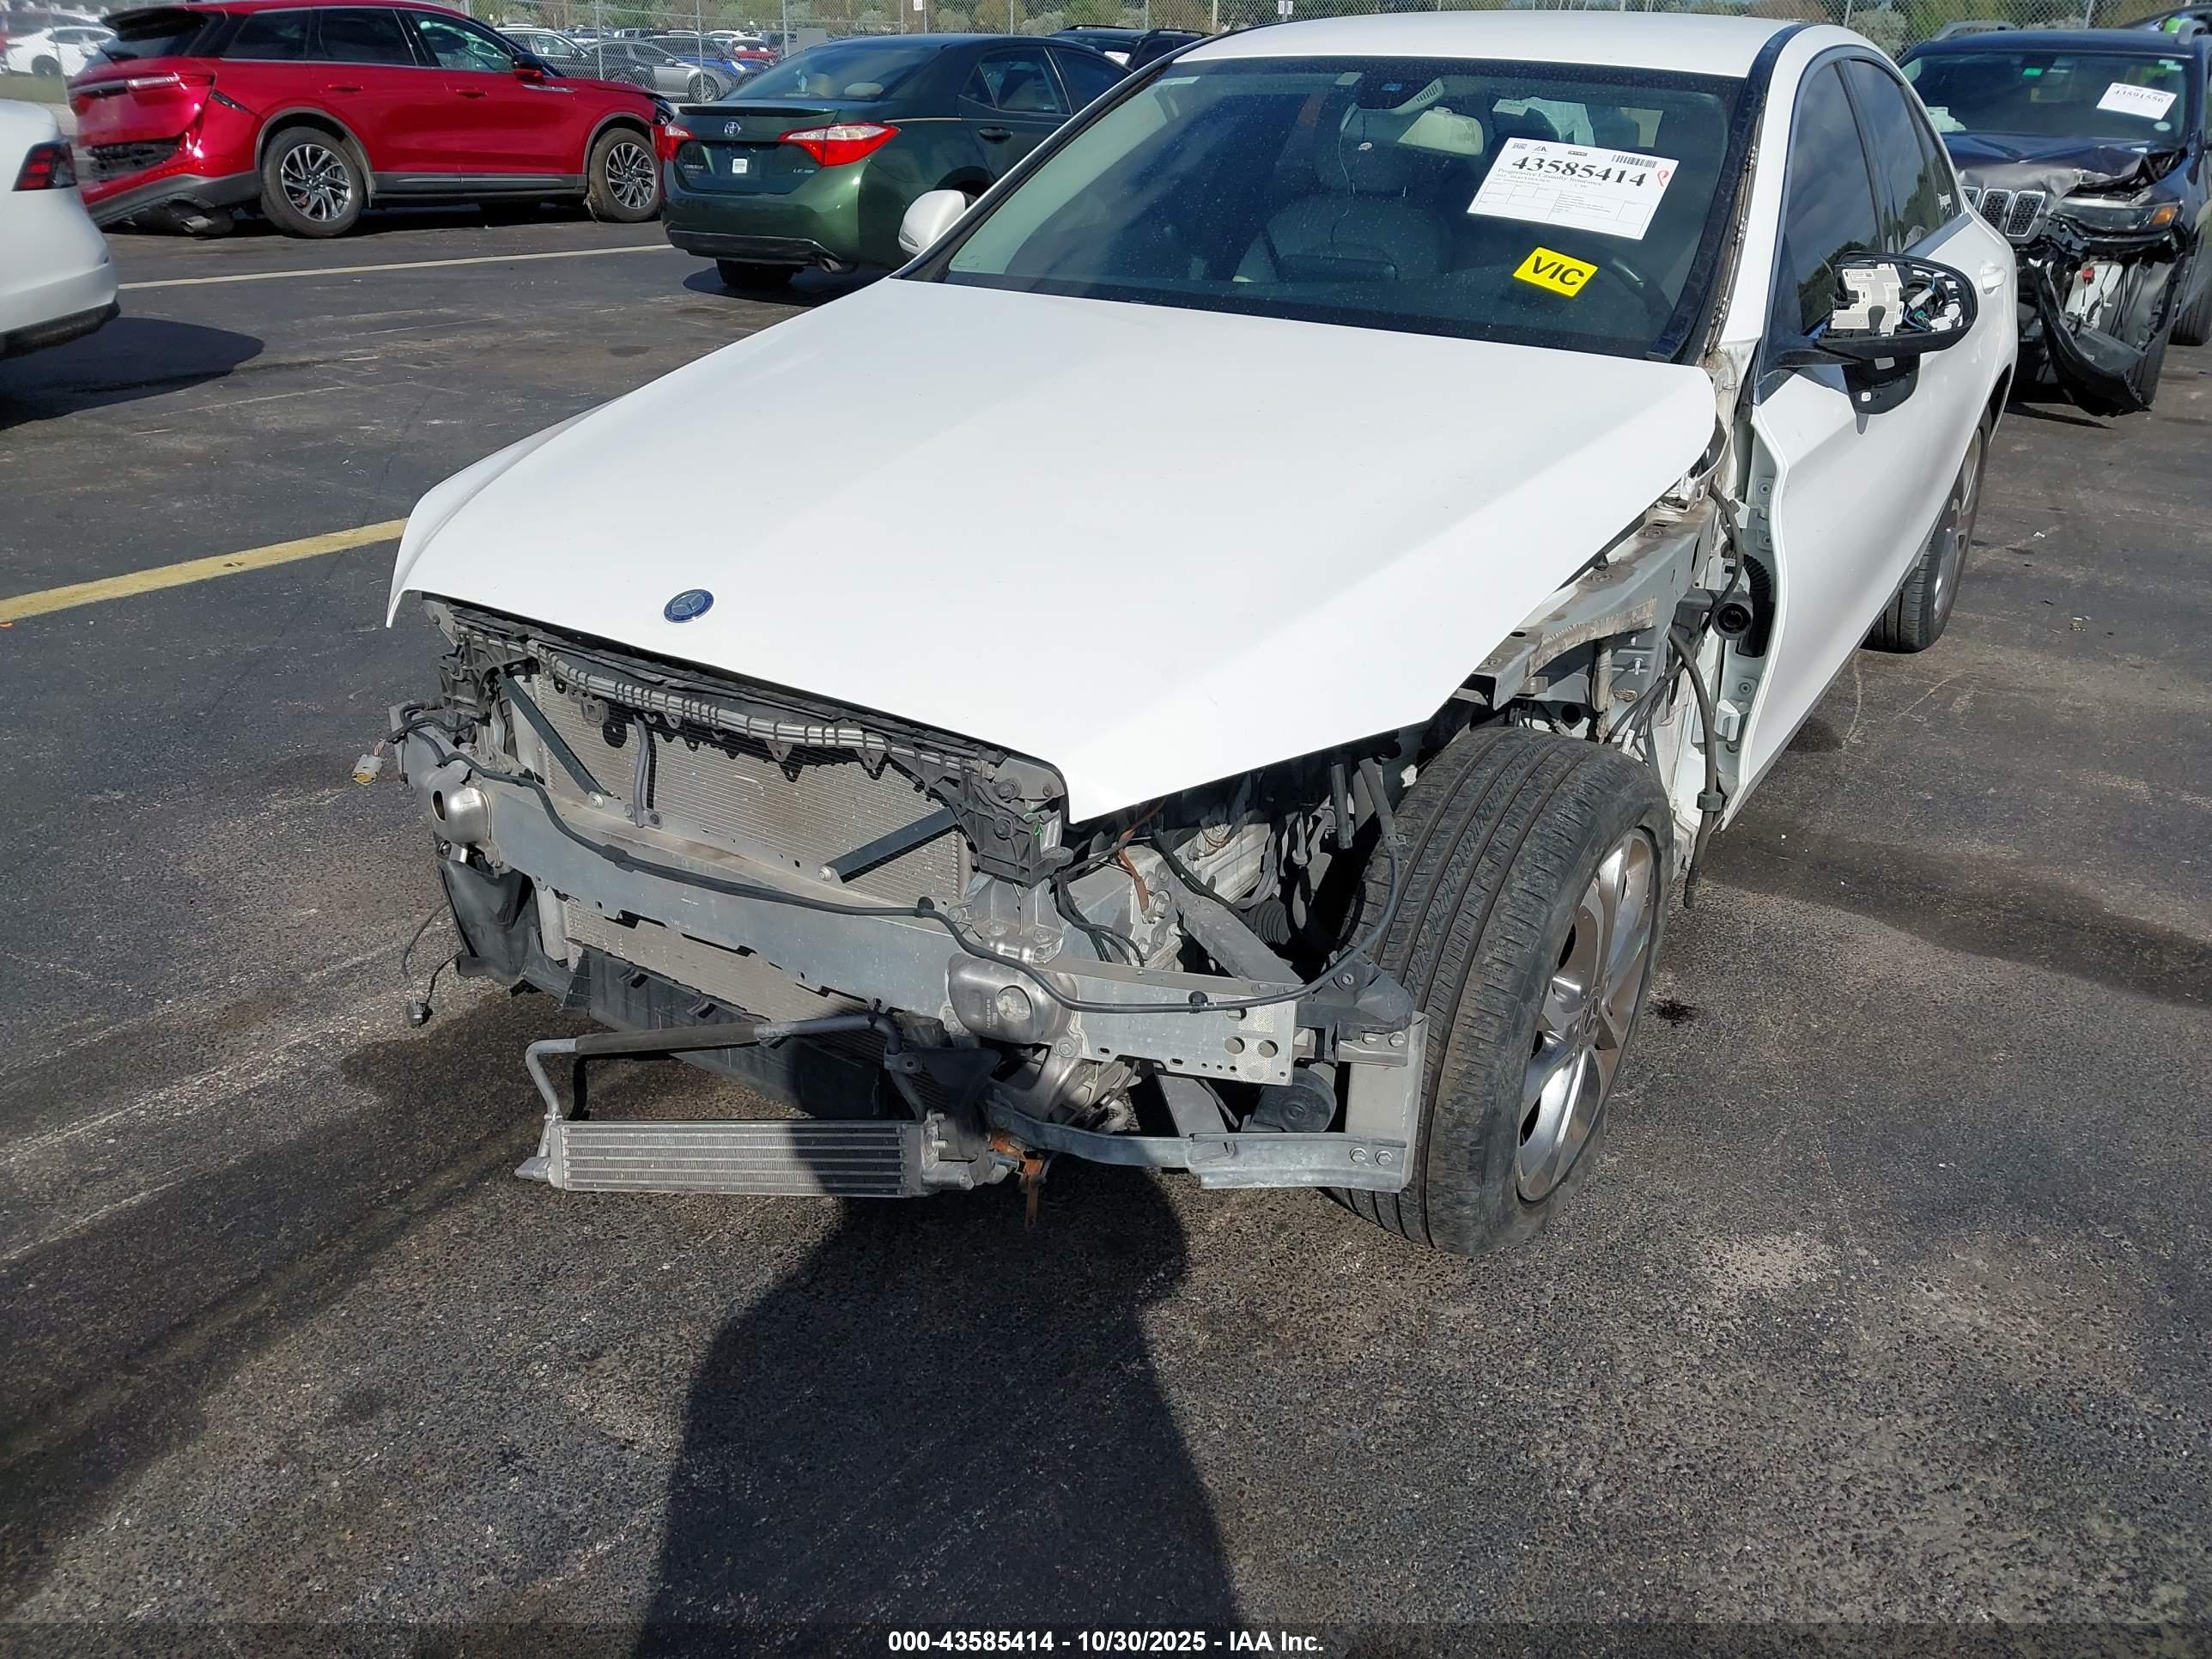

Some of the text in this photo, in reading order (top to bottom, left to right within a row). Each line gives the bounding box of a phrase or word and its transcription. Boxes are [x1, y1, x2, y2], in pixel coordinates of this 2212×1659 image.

[1498, 167, 1537, 178] Progressive
[1538, 173, 1567, 182] Casualty
[1570, 177, 1603, 186] Insurance
[1511, 156, 1646, 186] 43585414
[1531, 256, 1585, 286] VIC
